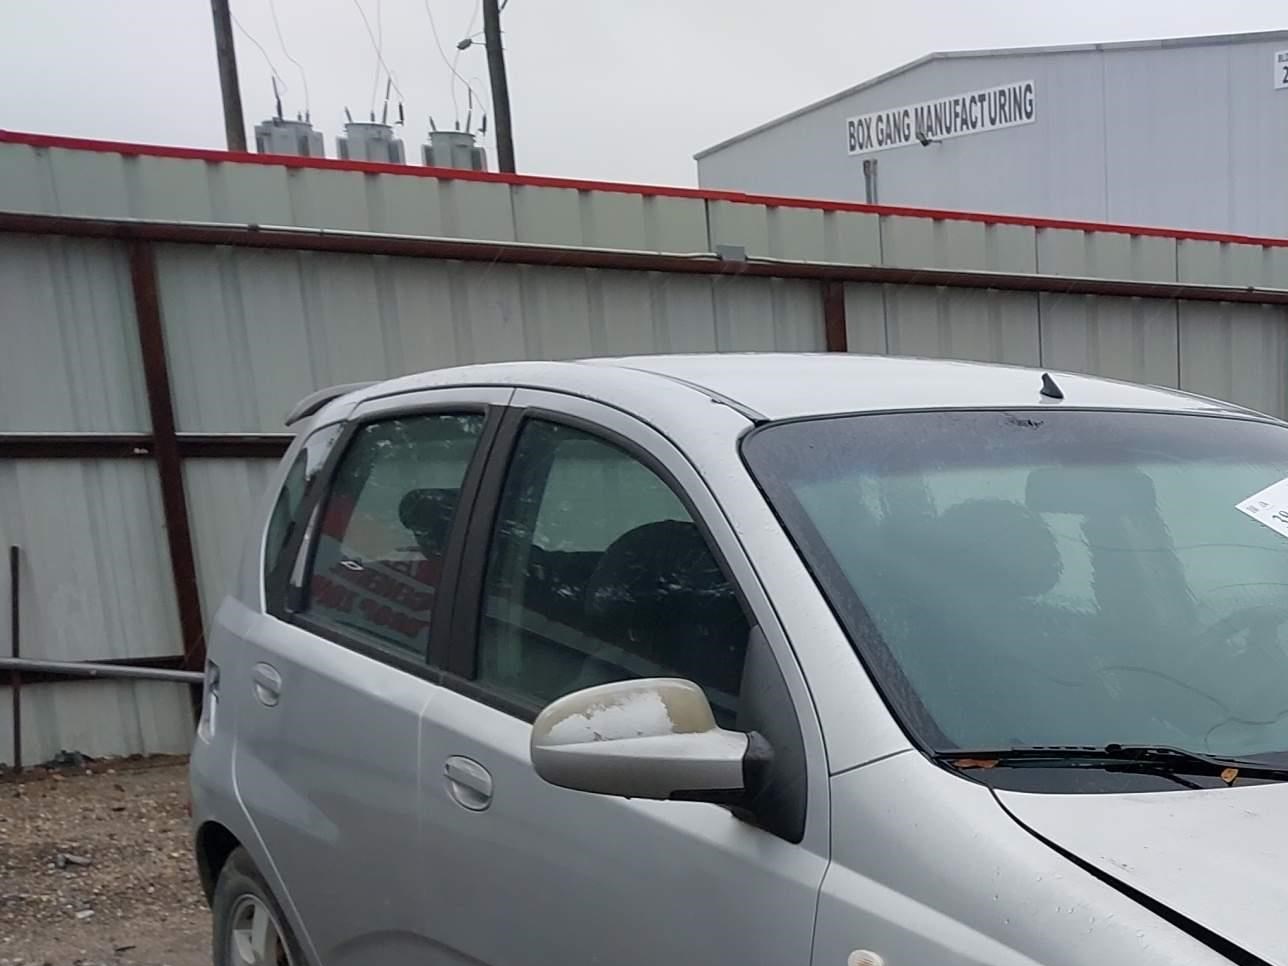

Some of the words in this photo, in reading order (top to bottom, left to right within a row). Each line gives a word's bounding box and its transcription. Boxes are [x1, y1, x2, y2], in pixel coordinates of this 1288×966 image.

[848, 117, 873, 152] BOX
[875, 109, 911, 147] GANG
[914, 83, 1033, 139] MANUFACTURING
